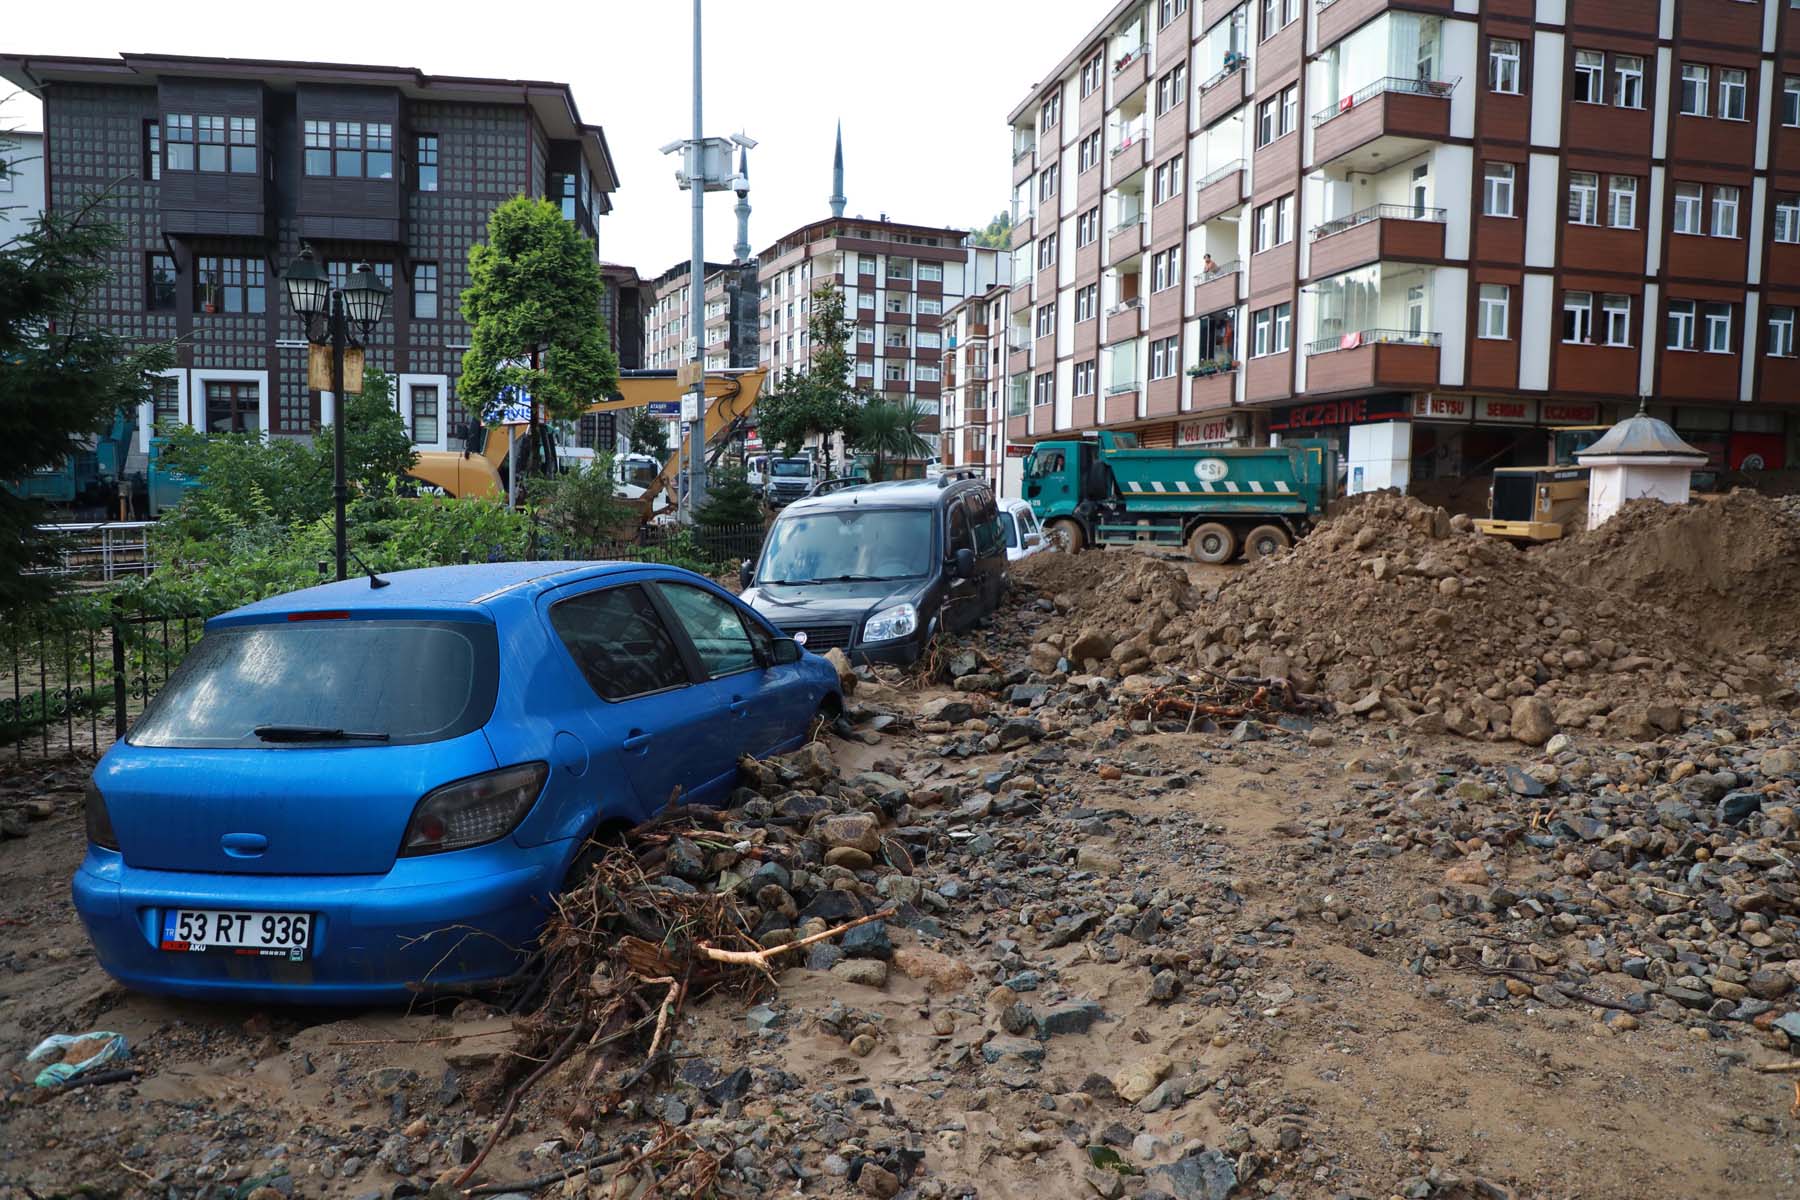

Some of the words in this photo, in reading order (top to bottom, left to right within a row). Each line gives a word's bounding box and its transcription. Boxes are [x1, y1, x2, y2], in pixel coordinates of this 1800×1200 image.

[165, 928, 175, 937] TR
[178, 912, 208, 942] 53
[215, 914, 252, 943] RT
[260, 915, 307, 945] 936
